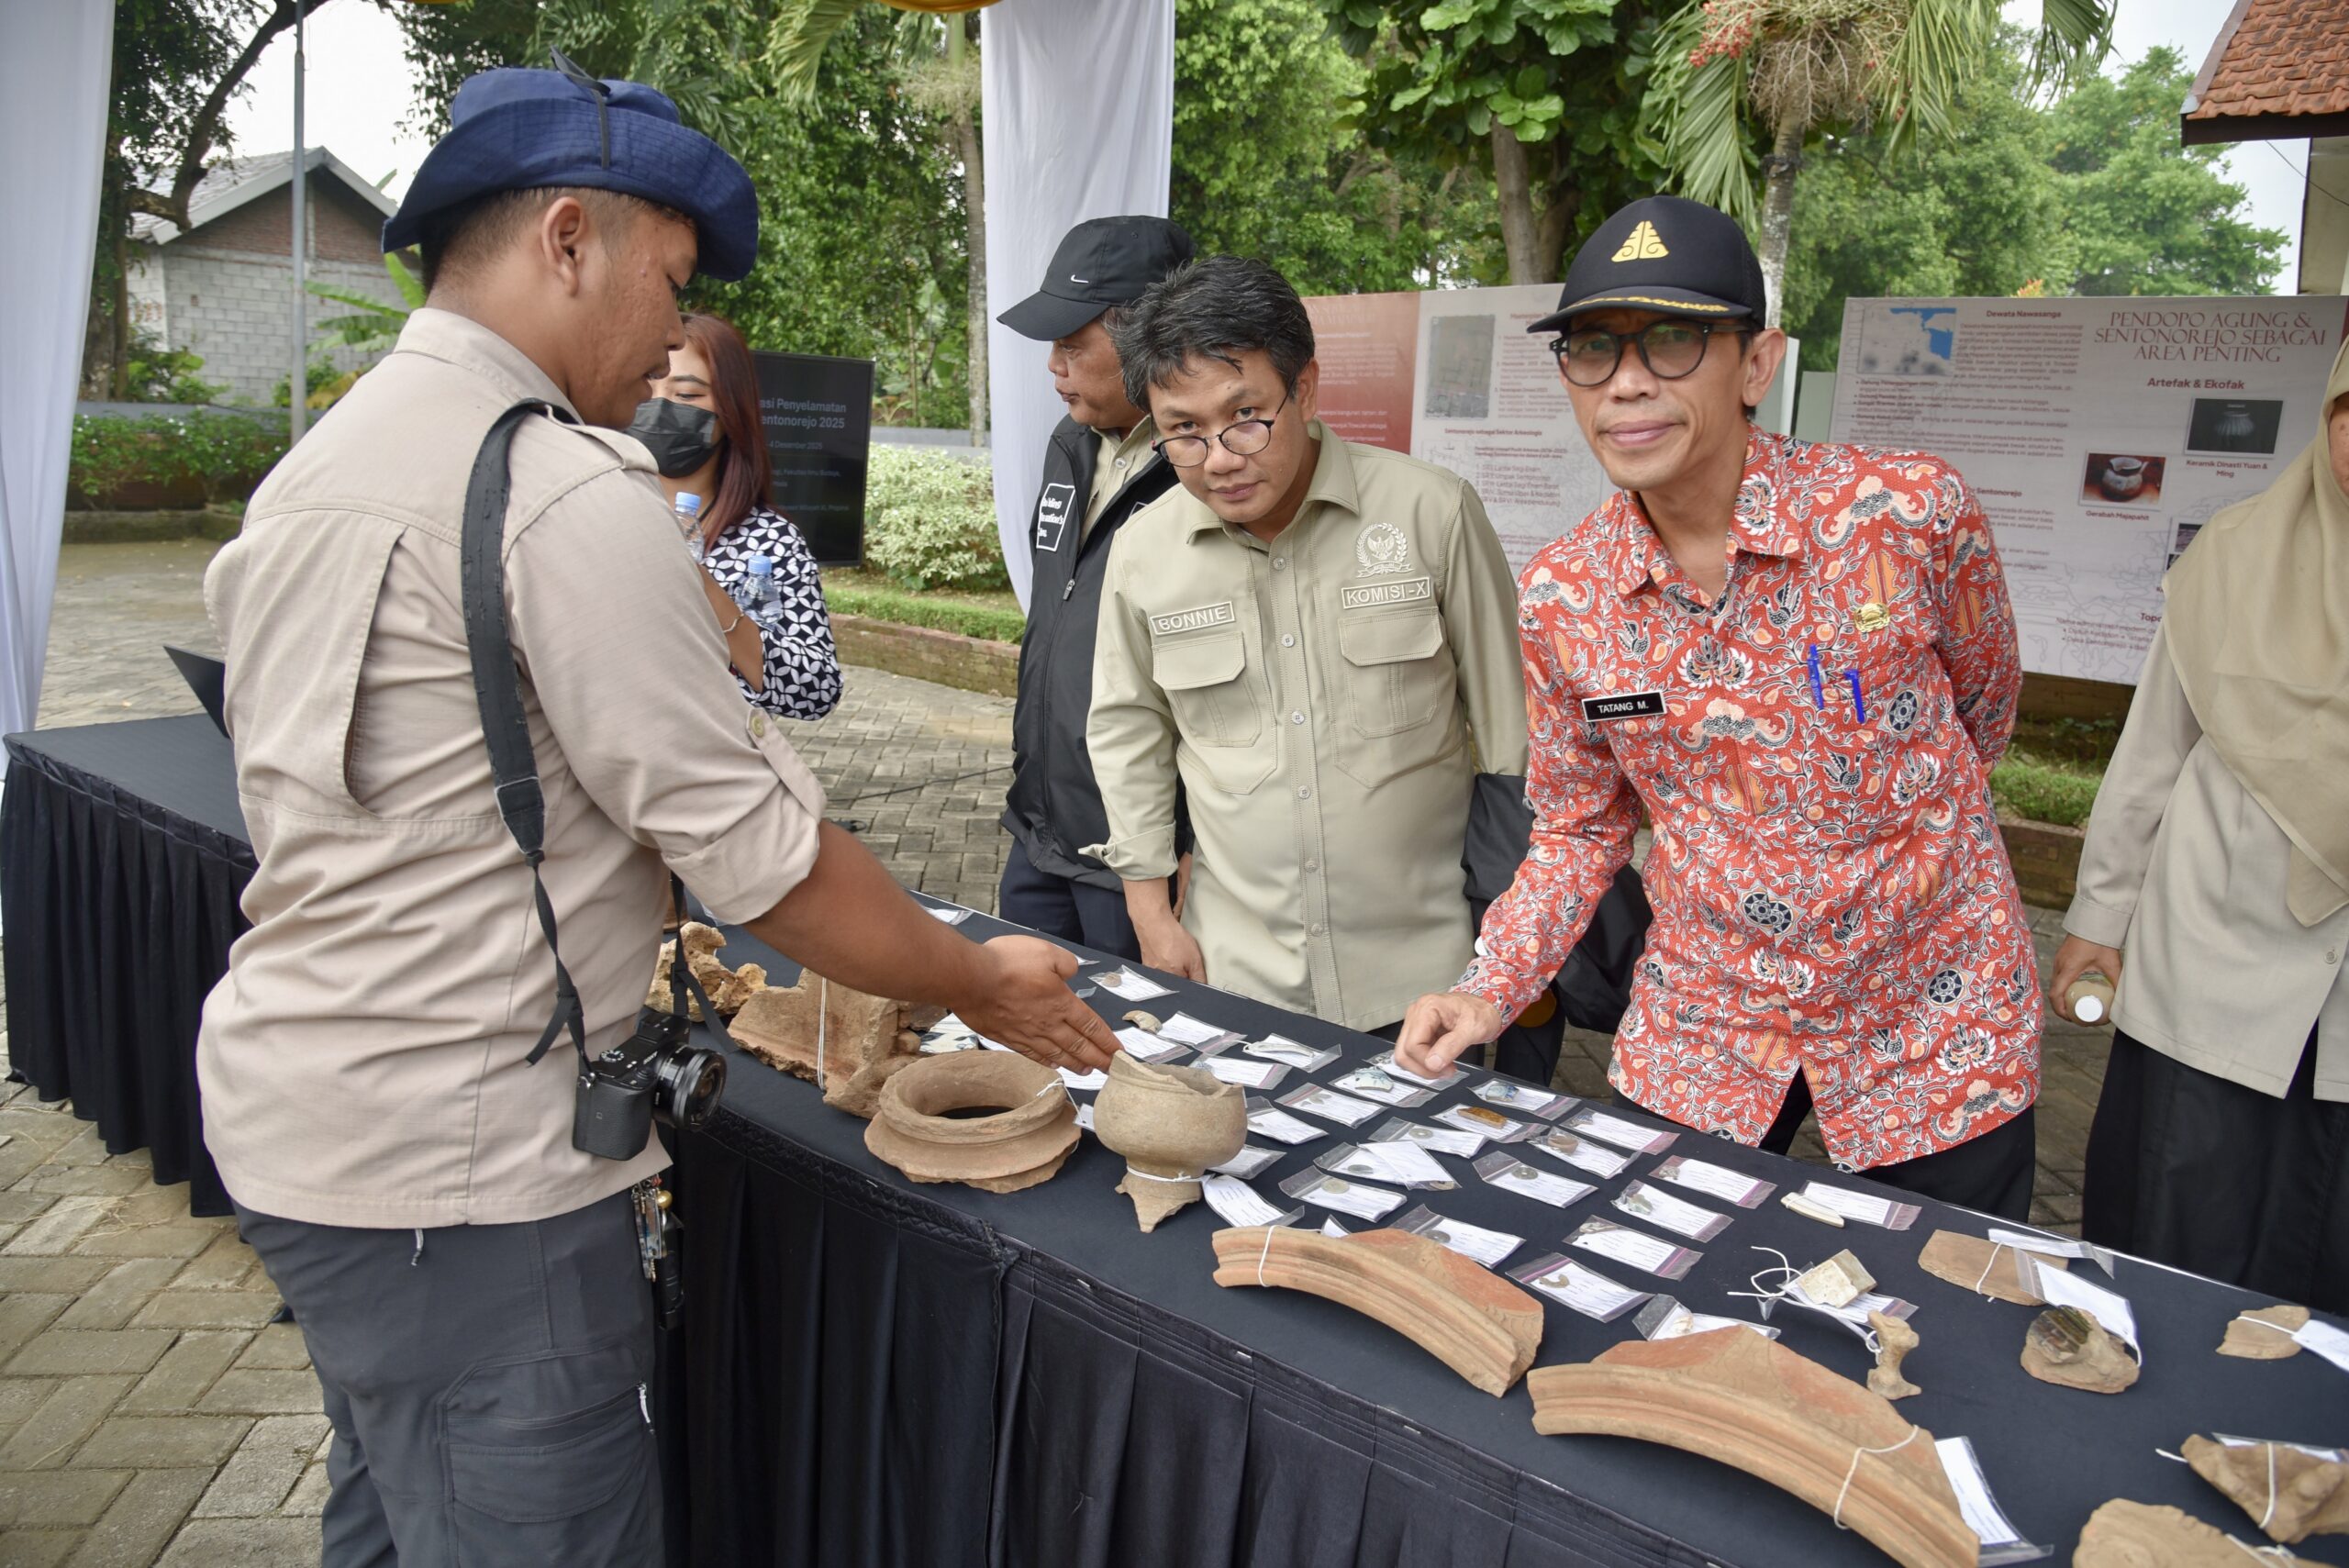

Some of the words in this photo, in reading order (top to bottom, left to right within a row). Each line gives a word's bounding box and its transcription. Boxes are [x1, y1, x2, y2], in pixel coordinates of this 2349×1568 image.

[2017, 310, 2062, 319] Nawasanga
[2110, 311, 2206, 328] PENDOPO
[2210, 311, 2288, 328] AGUNG
[2294, 311, 2312, 328] &
[2094, 328, 2236, 349] SENTONOREJO
[2241, 329, 2327, 346] SEBAGAI
[2134, 345, 2189, 361] AREA
[2192, 346, 2282, 362] PENTING
[2147, 377, 2191, 388] Artefak
[2193, 379, 2201, 388] &
[2204, 379, 2245, 389] Ekofak
[776, 398, 847, 413] Penyelamatan
[818, 417, 845, 428] 2025
[2186, 460, 2216, 468] Keramik
[2216, 460, 2243, 469] Dinasti
[2243, 462, 2262, 470] Yuan
[2216, 469, 2234, 479] Ming
[1976, 487, 2023, 498] Sentonorejo
[2085, 510, 2115, 519] Gerabah
[2115, 511, 2150, 522] Majapahit
[1159, 606, 1228, 631] BONNIE
[1597, 702, 1633, 714] TATANG
[1637, 700, 1650, 710] M.
